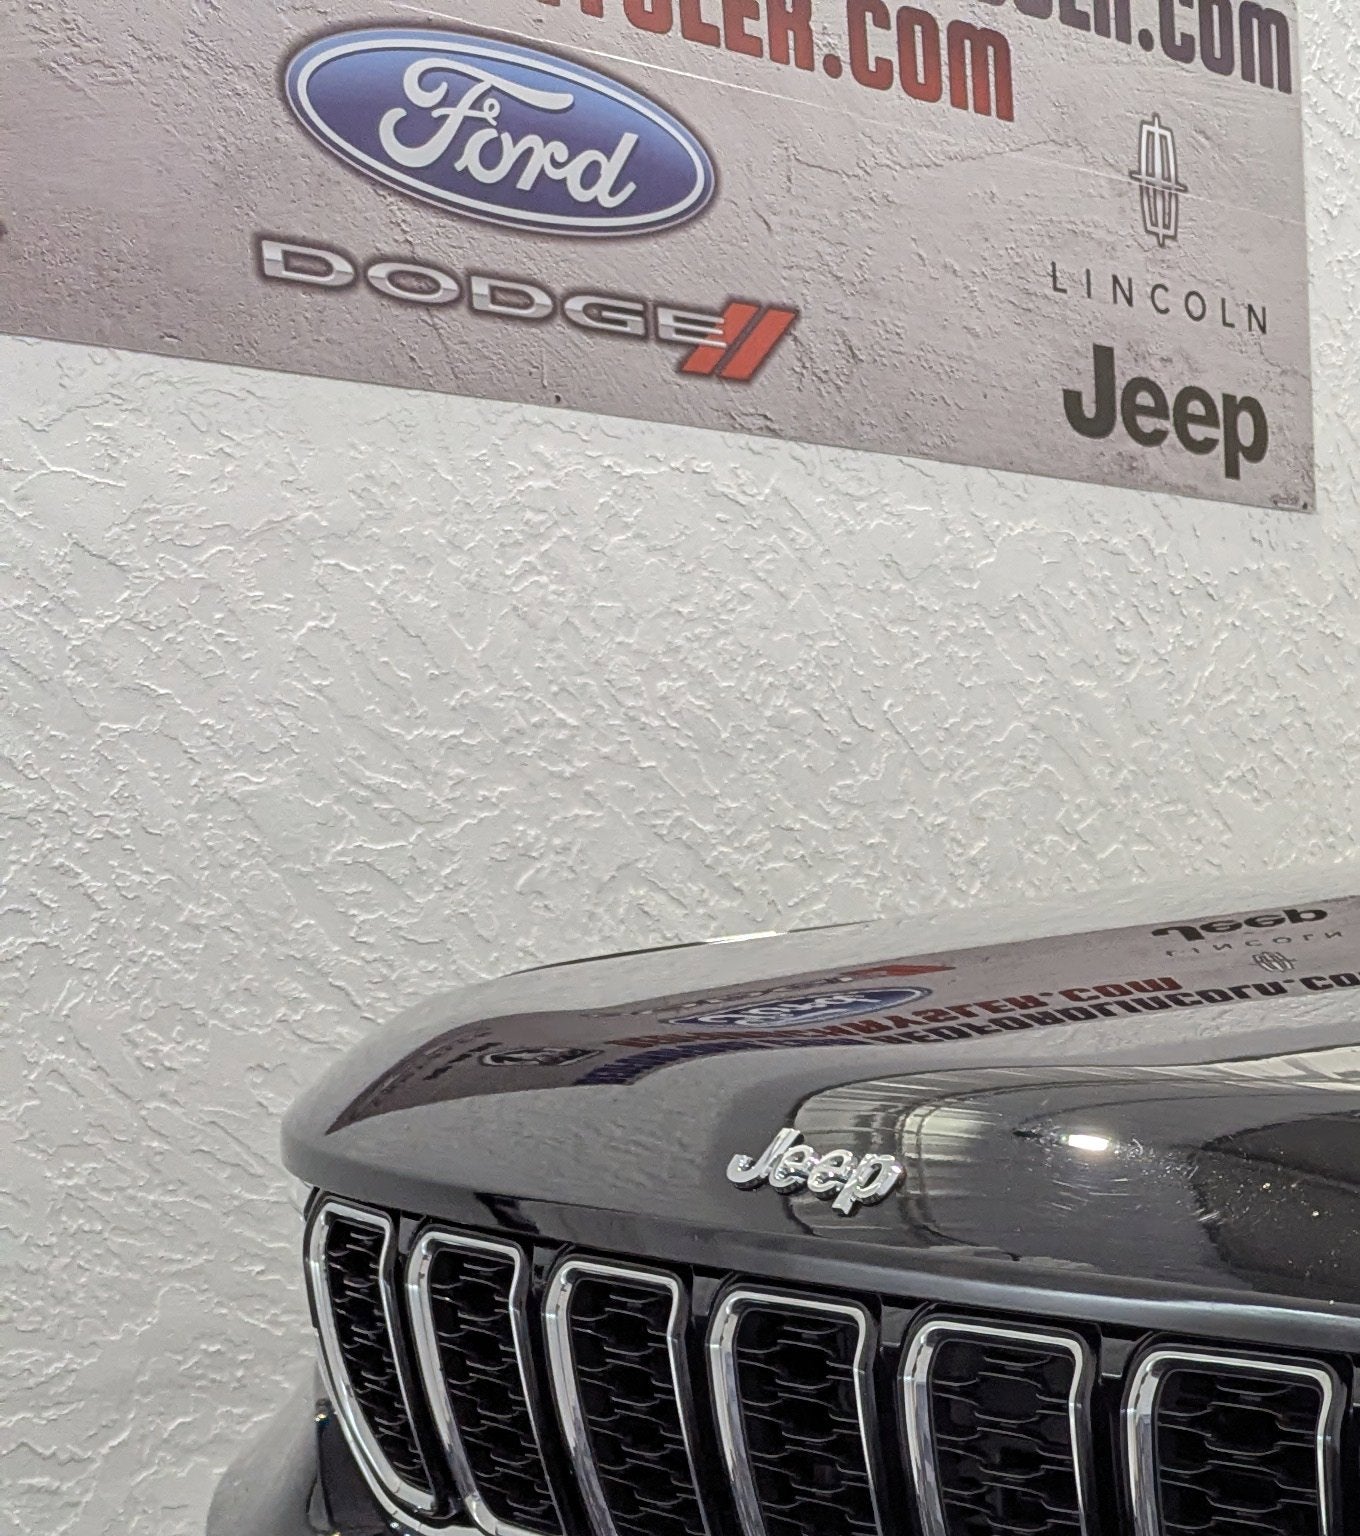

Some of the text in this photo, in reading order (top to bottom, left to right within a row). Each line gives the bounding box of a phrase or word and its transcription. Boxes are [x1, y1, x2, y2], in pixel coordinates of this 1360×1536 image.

[379, 58, 639, 208] Ford
[261, 240, 727, 349] DODGE
[1051, 261, 1267, 335] LINCOLN
[1062, 342, 1269, 481] Jeep
[727, 1128, 906, 1216] Jeep
